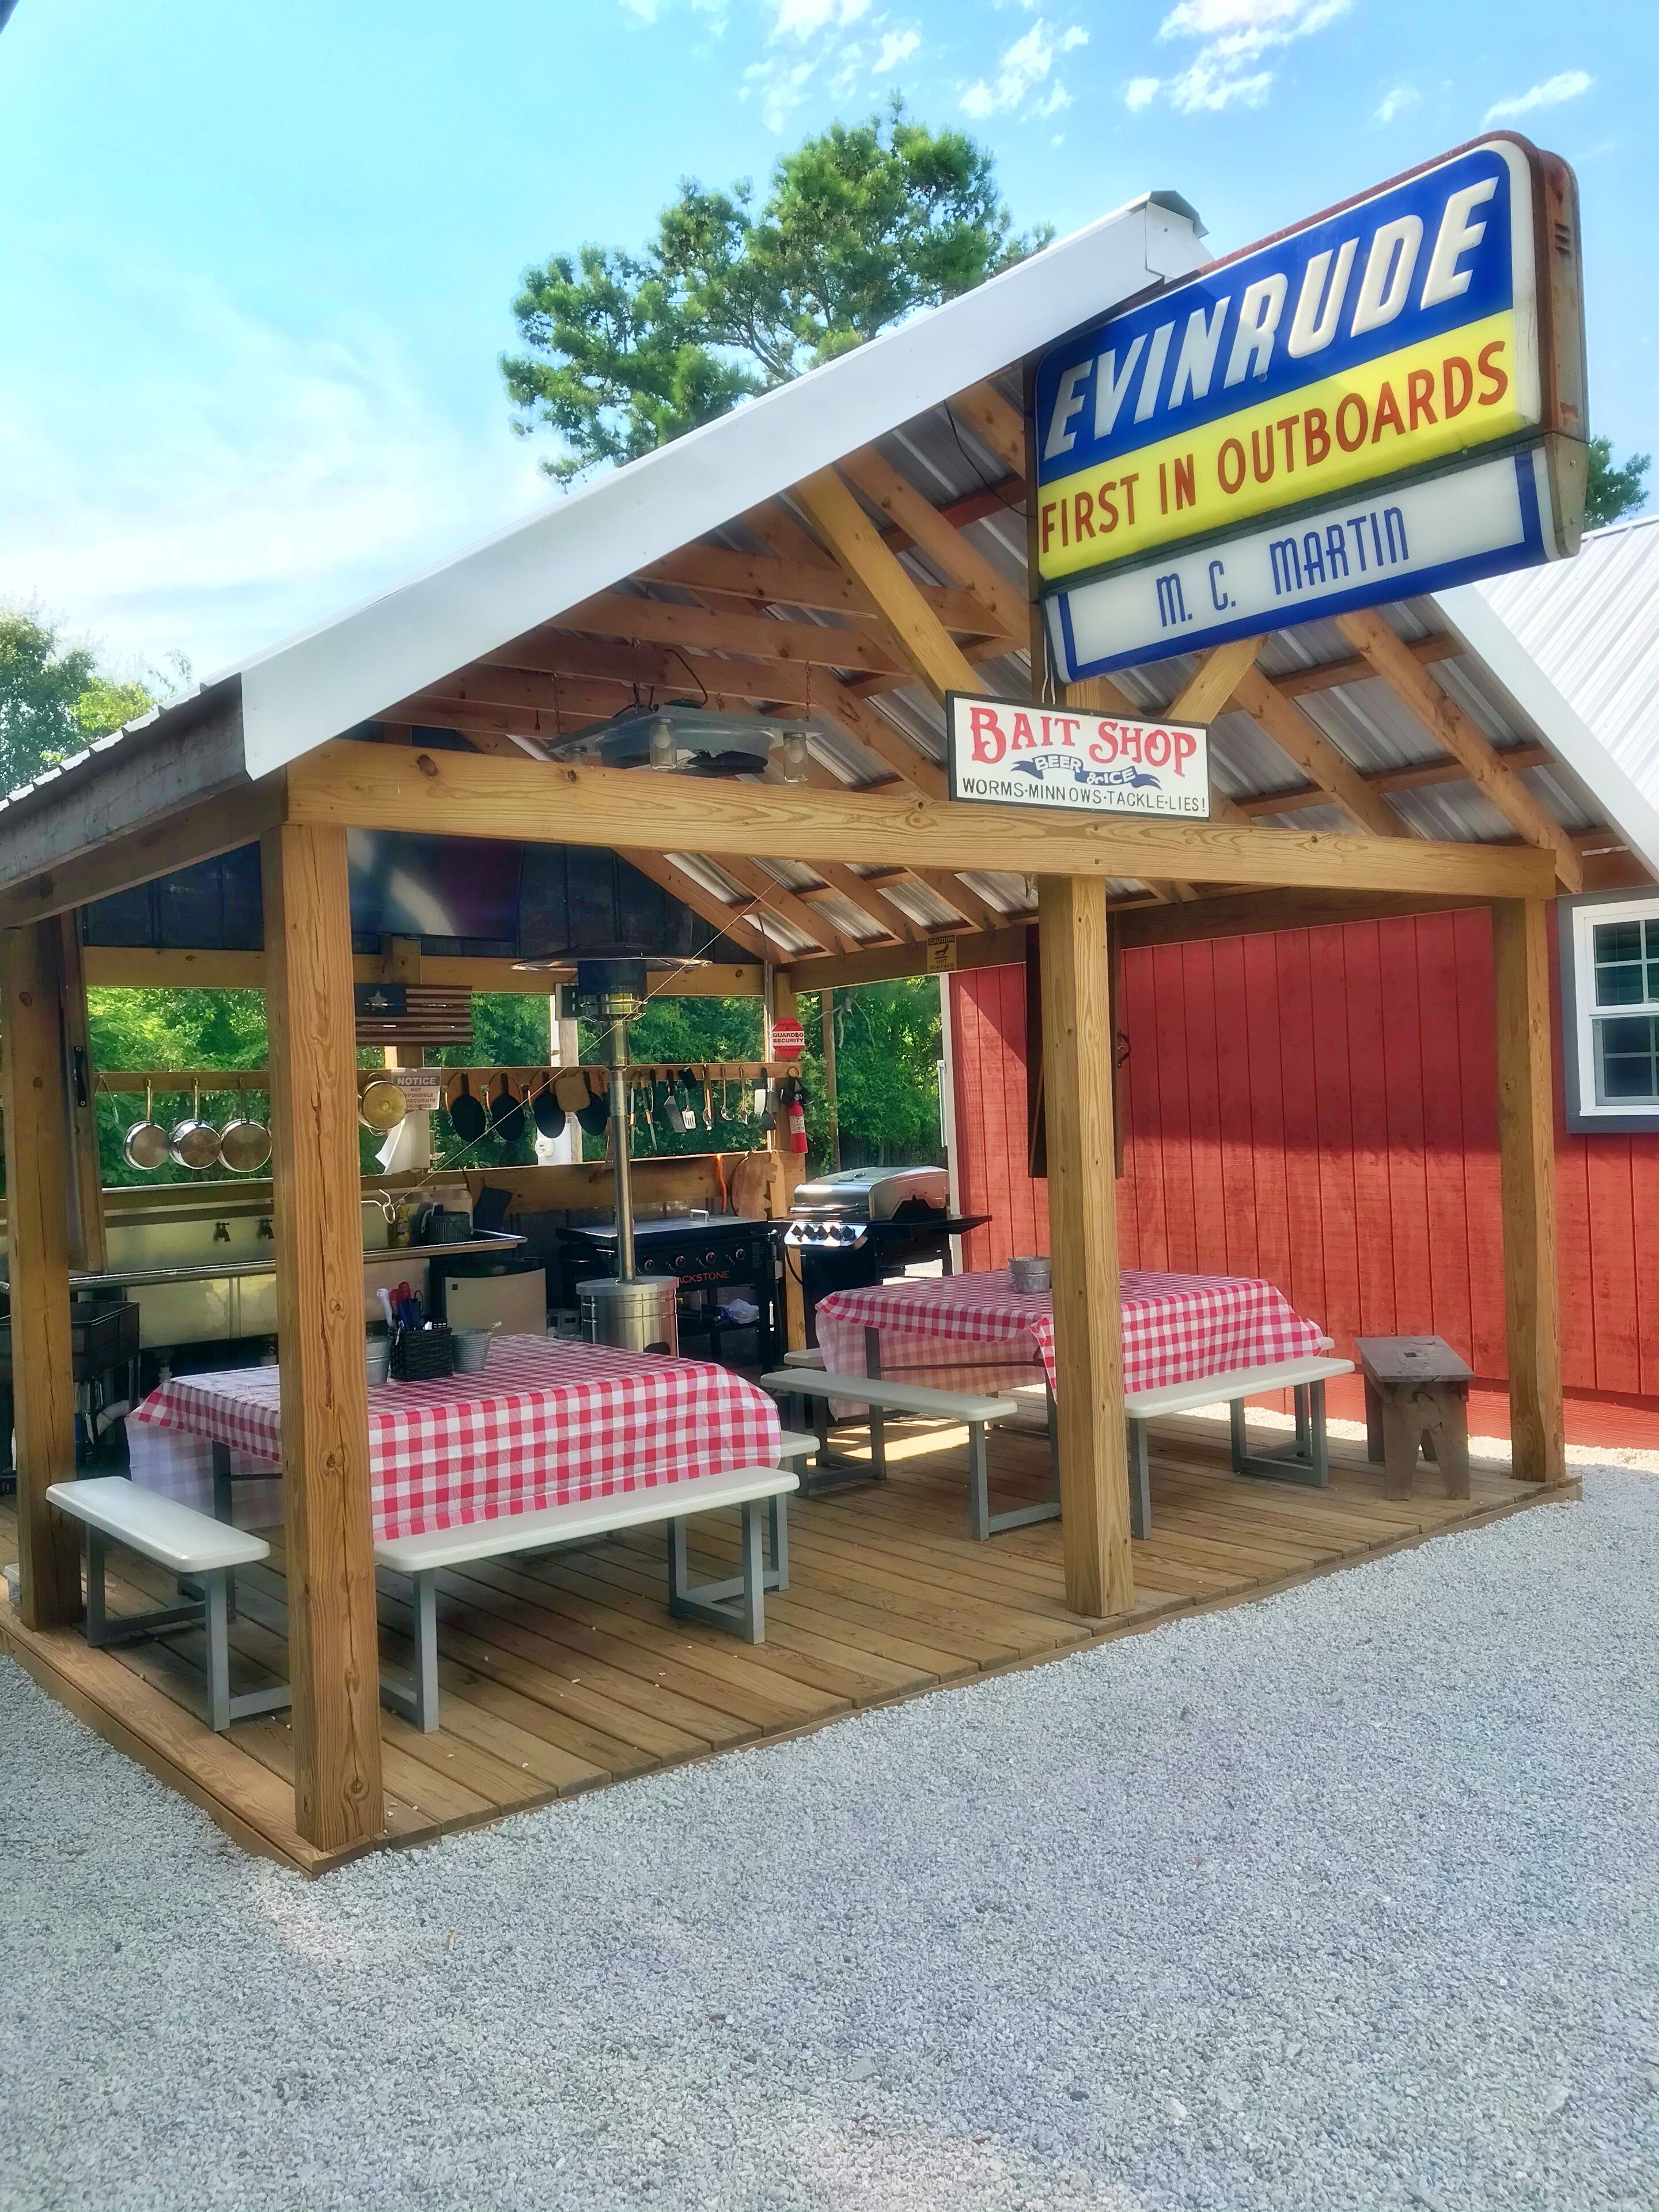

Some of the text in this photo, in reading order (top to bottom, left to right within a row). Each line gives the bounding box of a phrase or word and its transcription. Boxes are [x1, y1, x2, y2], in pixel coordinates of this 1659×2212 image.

[1043, 175, 1500, 461] EVINRUDE
[1041, 340, 1509, 554] FIRST IN OUTBOARDS
[1156, 505, 1410, 628] M. C. MARTIN
[969, 706, 1197, 778] BAIT SHOP
[1034, 755, 1082, 773] BEER
[929, 935, 955, 945] CAUTION
[397, 1077, 436, 1085] NOTICE
[678, 1270, 730, 1284] ACKSTONE
